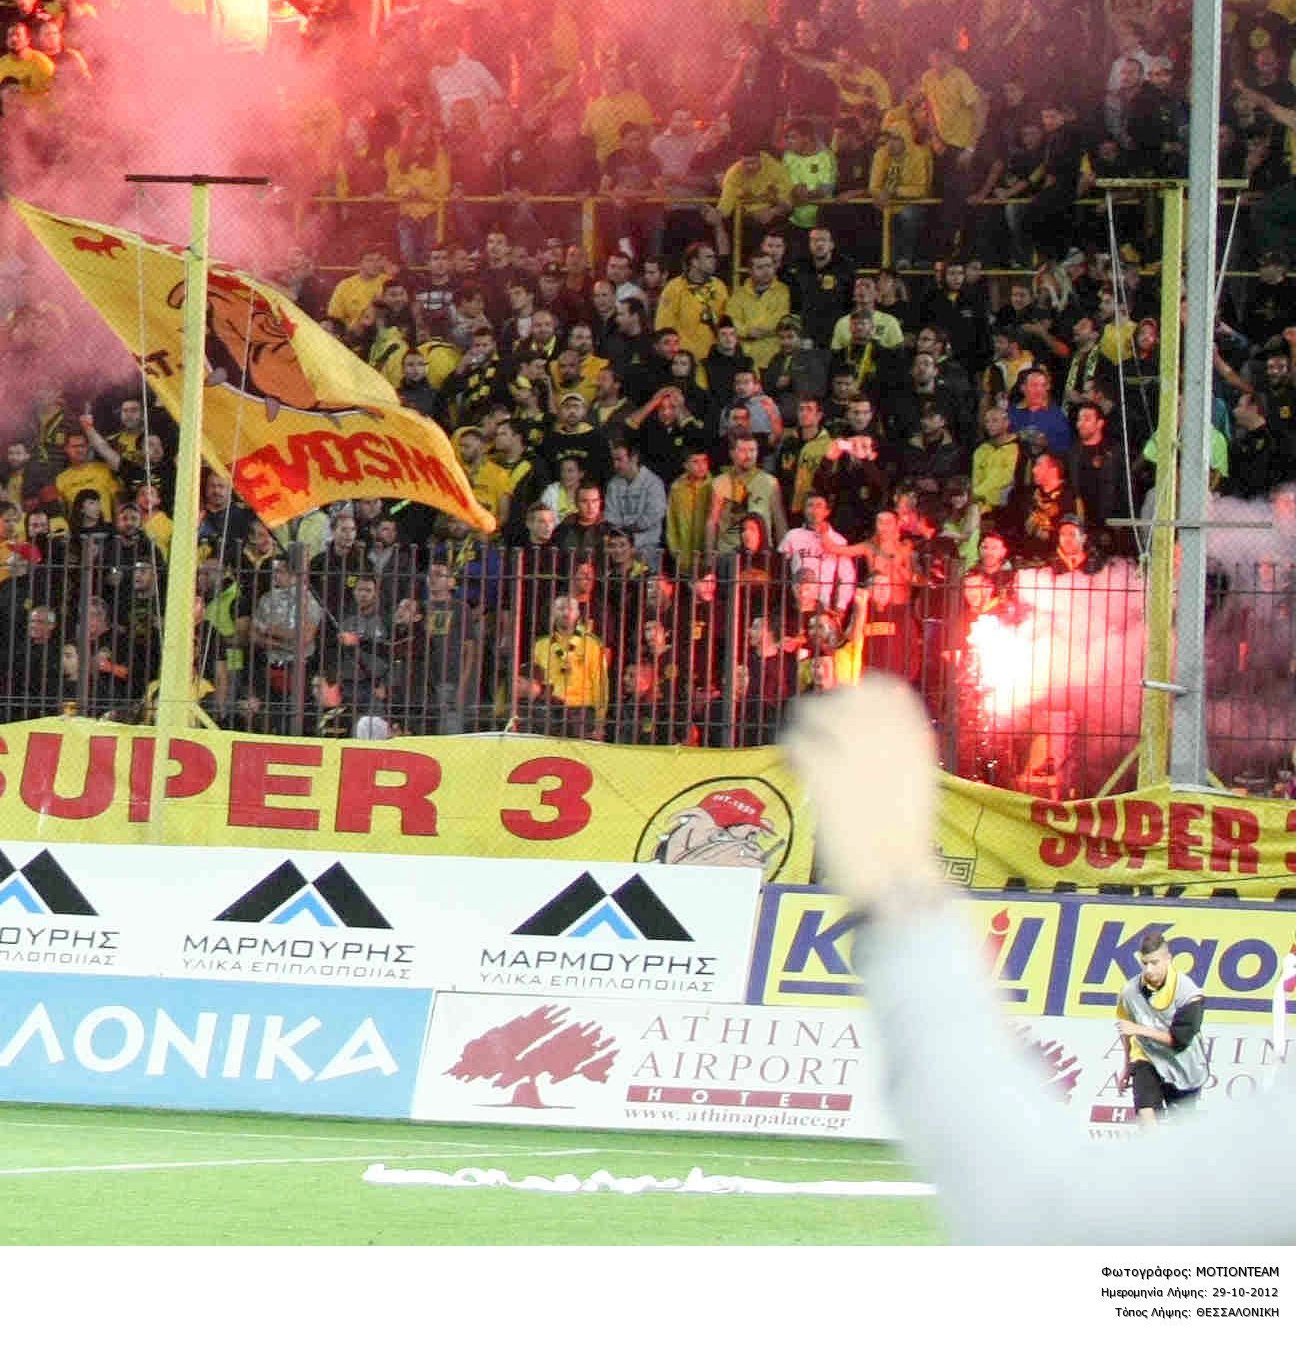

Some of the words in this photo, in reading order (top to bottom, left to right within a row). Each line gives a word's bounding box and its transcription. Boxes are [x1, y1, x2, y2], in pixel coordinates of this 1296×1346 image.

[500, 756, 595, 841] 3
[1030, 799, 1262, 874] SUPER
[184, 934, 415, 963] ΜΑΡΜΟΥΡΗΣ
[480, 949, 719, 976] ΜΑΡΜΟΥΡΗΣ
[182, 958, 242, 971] ΥΛΙΚΑ
[480, 973, 543, 985] ΥΛΙΚΑ
[640, 1014, 863, 1049] ATHINA
[632, 1050, 859, 1086] AIRPORT
[647, 1086, 831, 1110] HOTEL
